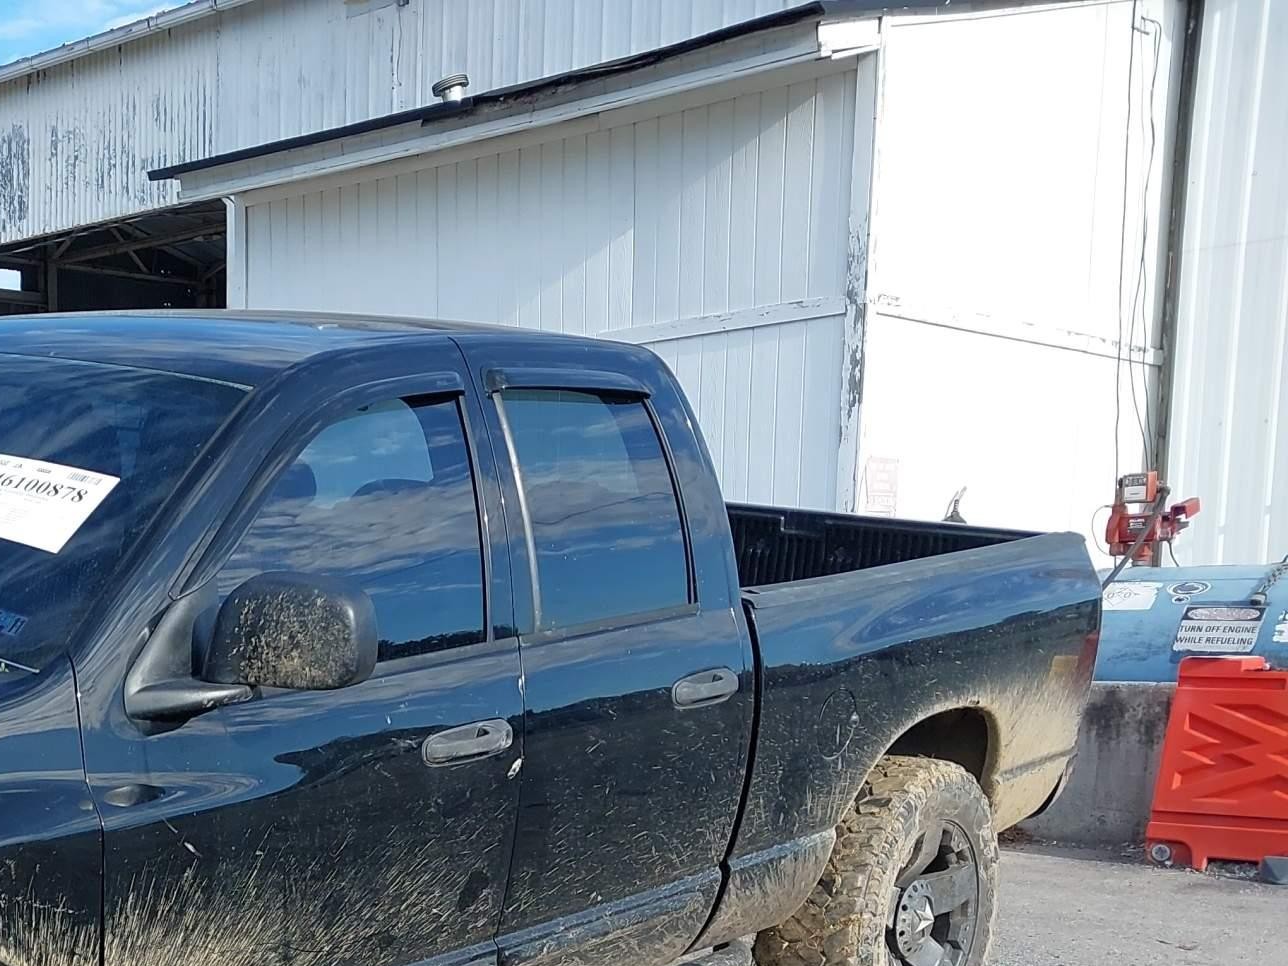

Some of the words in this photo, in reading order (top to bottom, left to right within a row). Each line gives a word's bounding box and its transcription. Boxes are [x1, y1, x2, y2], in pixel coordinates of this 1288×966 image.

[1180, 625, 1203, 633] TURN
[1205, 625, 1222, 633] OFF
[1222, 626, 1258, 634] ENGINE
[1176, 636, 1204, 644] WHILE
[1204, 637, 1253, 645] REFUELING
